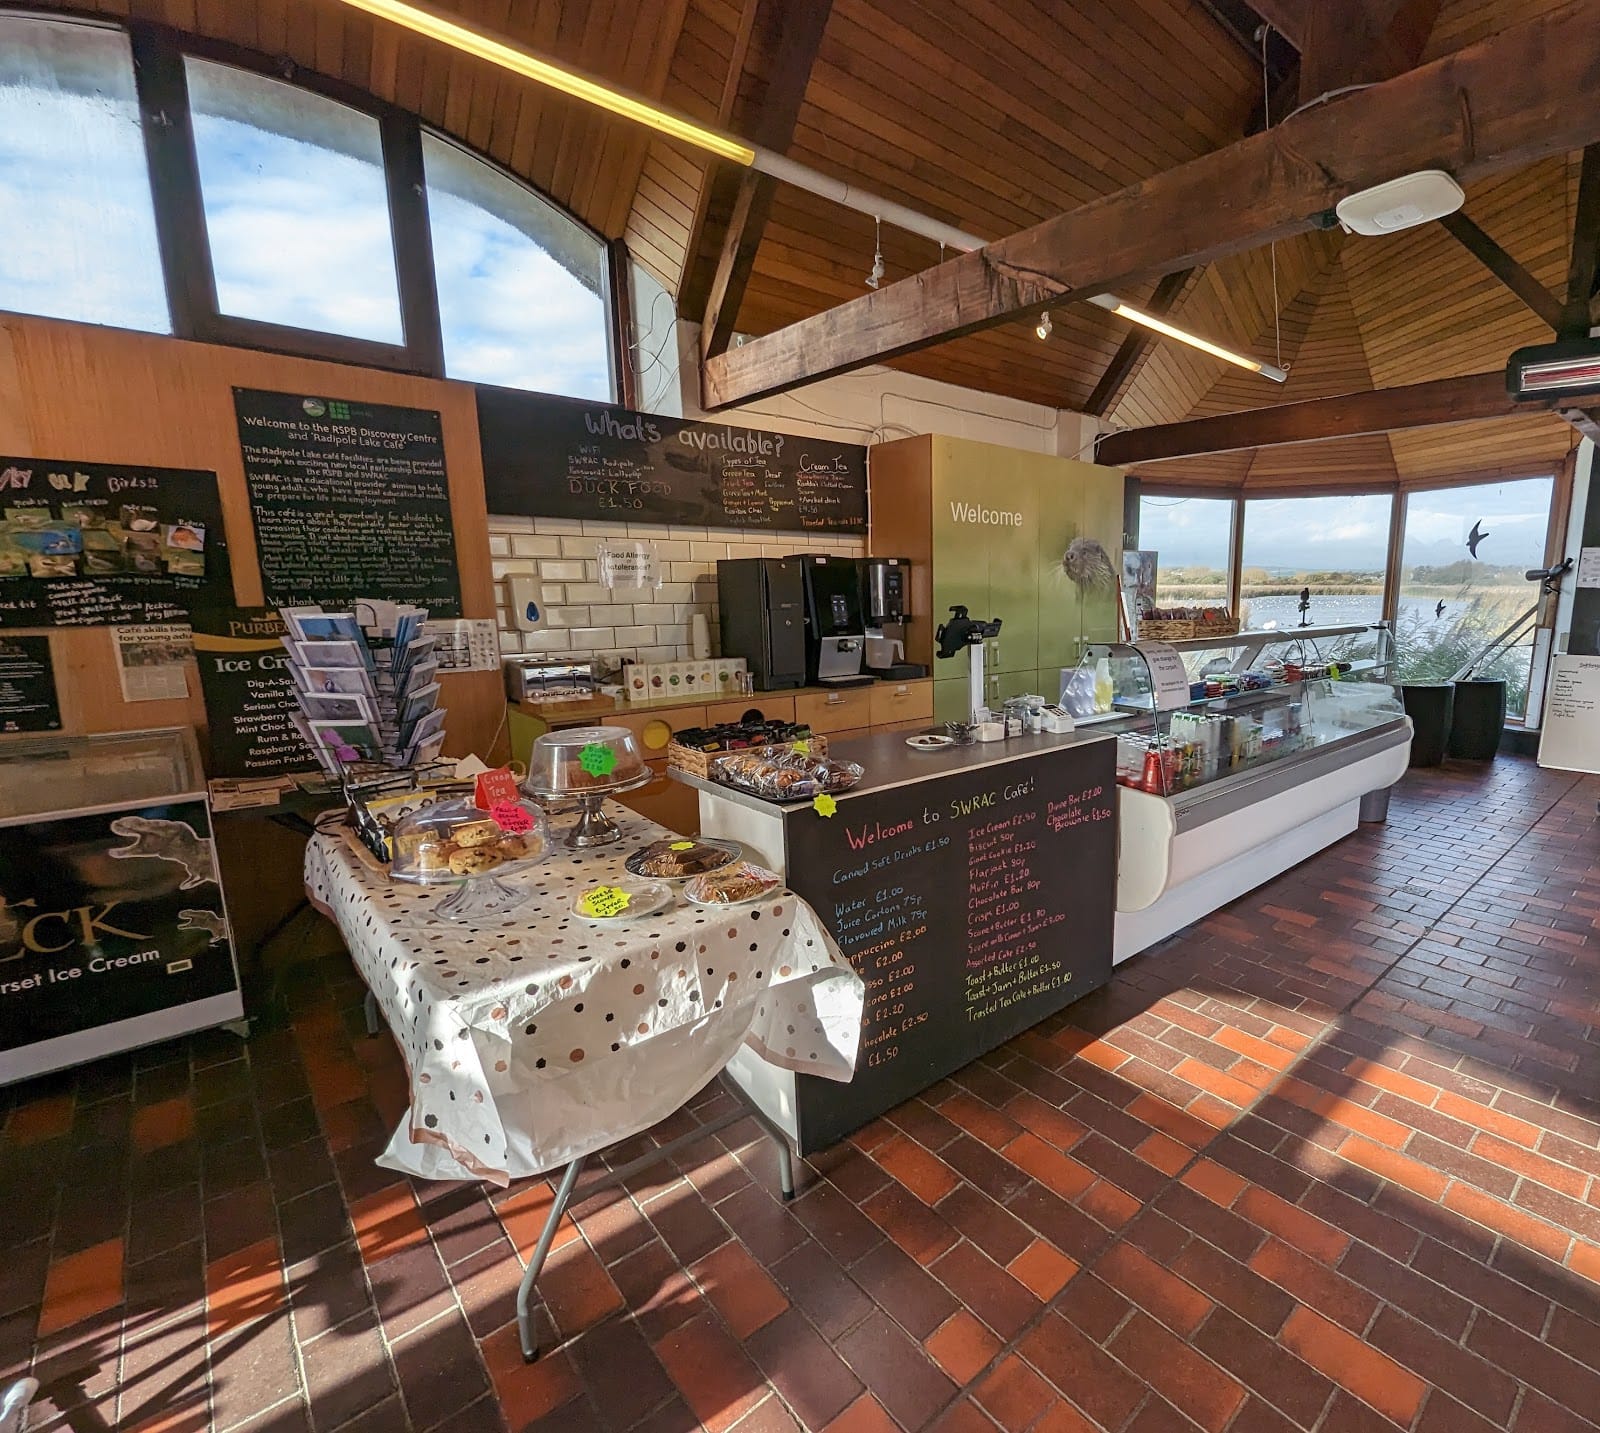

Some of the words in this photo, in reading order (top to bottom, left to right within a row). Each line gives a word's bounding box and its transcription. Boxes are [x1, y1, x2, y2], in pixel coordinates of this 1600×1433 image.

[243, 416, 297, 429] Welcome
[299, 421, 310, 431] to
[312, 423, 329, 432] the
[332, 425, 357, 436] RSPB
[360, 428, 406, 442] Discovery
[407, 433, 437, 444] Centre
[584, 410, 661, 443] What's
[679, 427, 784, 458] available?
[288, 432, 308, 440] and
[360, 437, 381, 448] Lake
[243, 445, 261, 454] The
[262, 446, 300, 458] Radipole
[302, 449, 321, 458] Lake
[721, 454, 742, 467] Types
[744, 457, 752, 465] of
[755, 456, 767, 465] Tea
[800, 453, 829, 472] Cream
[832, 454, 848, 470] Tea
[570, 479, 619, 494] DUCK
[629, 482, 672, 495] FOOD
[253, 505, 275, 517] This
[950, 501, 1023, 526] Welcome
[625, 551, 650, 560] Allegy
[267, 596, 284, 606] We
[117, 626, 141, 634] Café
[118, 634, 135, 642] for
[137, 634, 171, 642] young
[214, 657, 251, 673] Ice
[250, 690, 285, 699] Vanilla
[243, 703, 276, 711] Serious
[233, 713, 286, 724] Strawberry
[236, 725, 258, 735] Mint
[260, 722, 285, 731] Choc
[257, 734, 279, 743] Rum
[281, 733, 289, 741] &
[249, 743, 297, 756] Raspberry
[245, 758, 282, 768] Passion
[284, 754, 305, 763] Fruit
[489, 786, 507, 797] Tea
[846, 819, 914, 850] Welcome
[923, 807, 940, 824] to
[950, 791, 997, 819] SWRAC
[1003, 776, 1035, 801] Café!
[1046, 806, 1082, 826] Chocolate
[968, 828, 985, 840] Ice
[986, 820, 1011, 833] Cream
[1055, 815, 1090, 832] Brownie
[968, 837, 998, 853] Biscuit
[833, 861, 869, 884] Canned
[872, 855, 891, 870] Soft
[894, 844, 922, 862] Drinks
[925, 836, 951, 852] £1.50
[968, 860, 1009, 880] Flapjack
[969, 880, 999, 894] Muffin
[835, 898, 866, 918] Water
[875, 887, 904, 903] £1.00
[968, 890, 1008, 909] Chocolate
[1010, 884, 1023, 895] Bar
[836, 918, 861, 932] Juice
[864, 904, 900, 922] Cartons
[968, 911, 993, 925] Crisps
[995, 901, 1020, 916] £1.00
[0, 898, 154, 963] CK
[837, 922, 883, 946] Flavoured
[887, 915, 908, 931] Milk
[900, 925, 927, 942] £2.00
[875, 951, 904, 968] £2.00
[966, 951, 997, 968] Assorted
[0, 973, 42, 995] rset
[49, 967, 82, 984] Ice
[88, 950, 160, 974] Cream
[888, 964, 916, 982] £2.00
[965, 969, 986, 986] Toast
[993, 962, 1017, 976] Butter
[890, 982, 914, 998] £2.00
[965, 987, 986, 1002] Toast
[992, 979, 1013, 996] Jam
[1018, 970, 1039, 985] Butter
[875, 1003, 905, 1021] £2.20
[864, 1026, 897, 1048] hocolate
[901, 1011, 929, 1032] £2.50
[868, 1046, 899, 1067] £1.50
